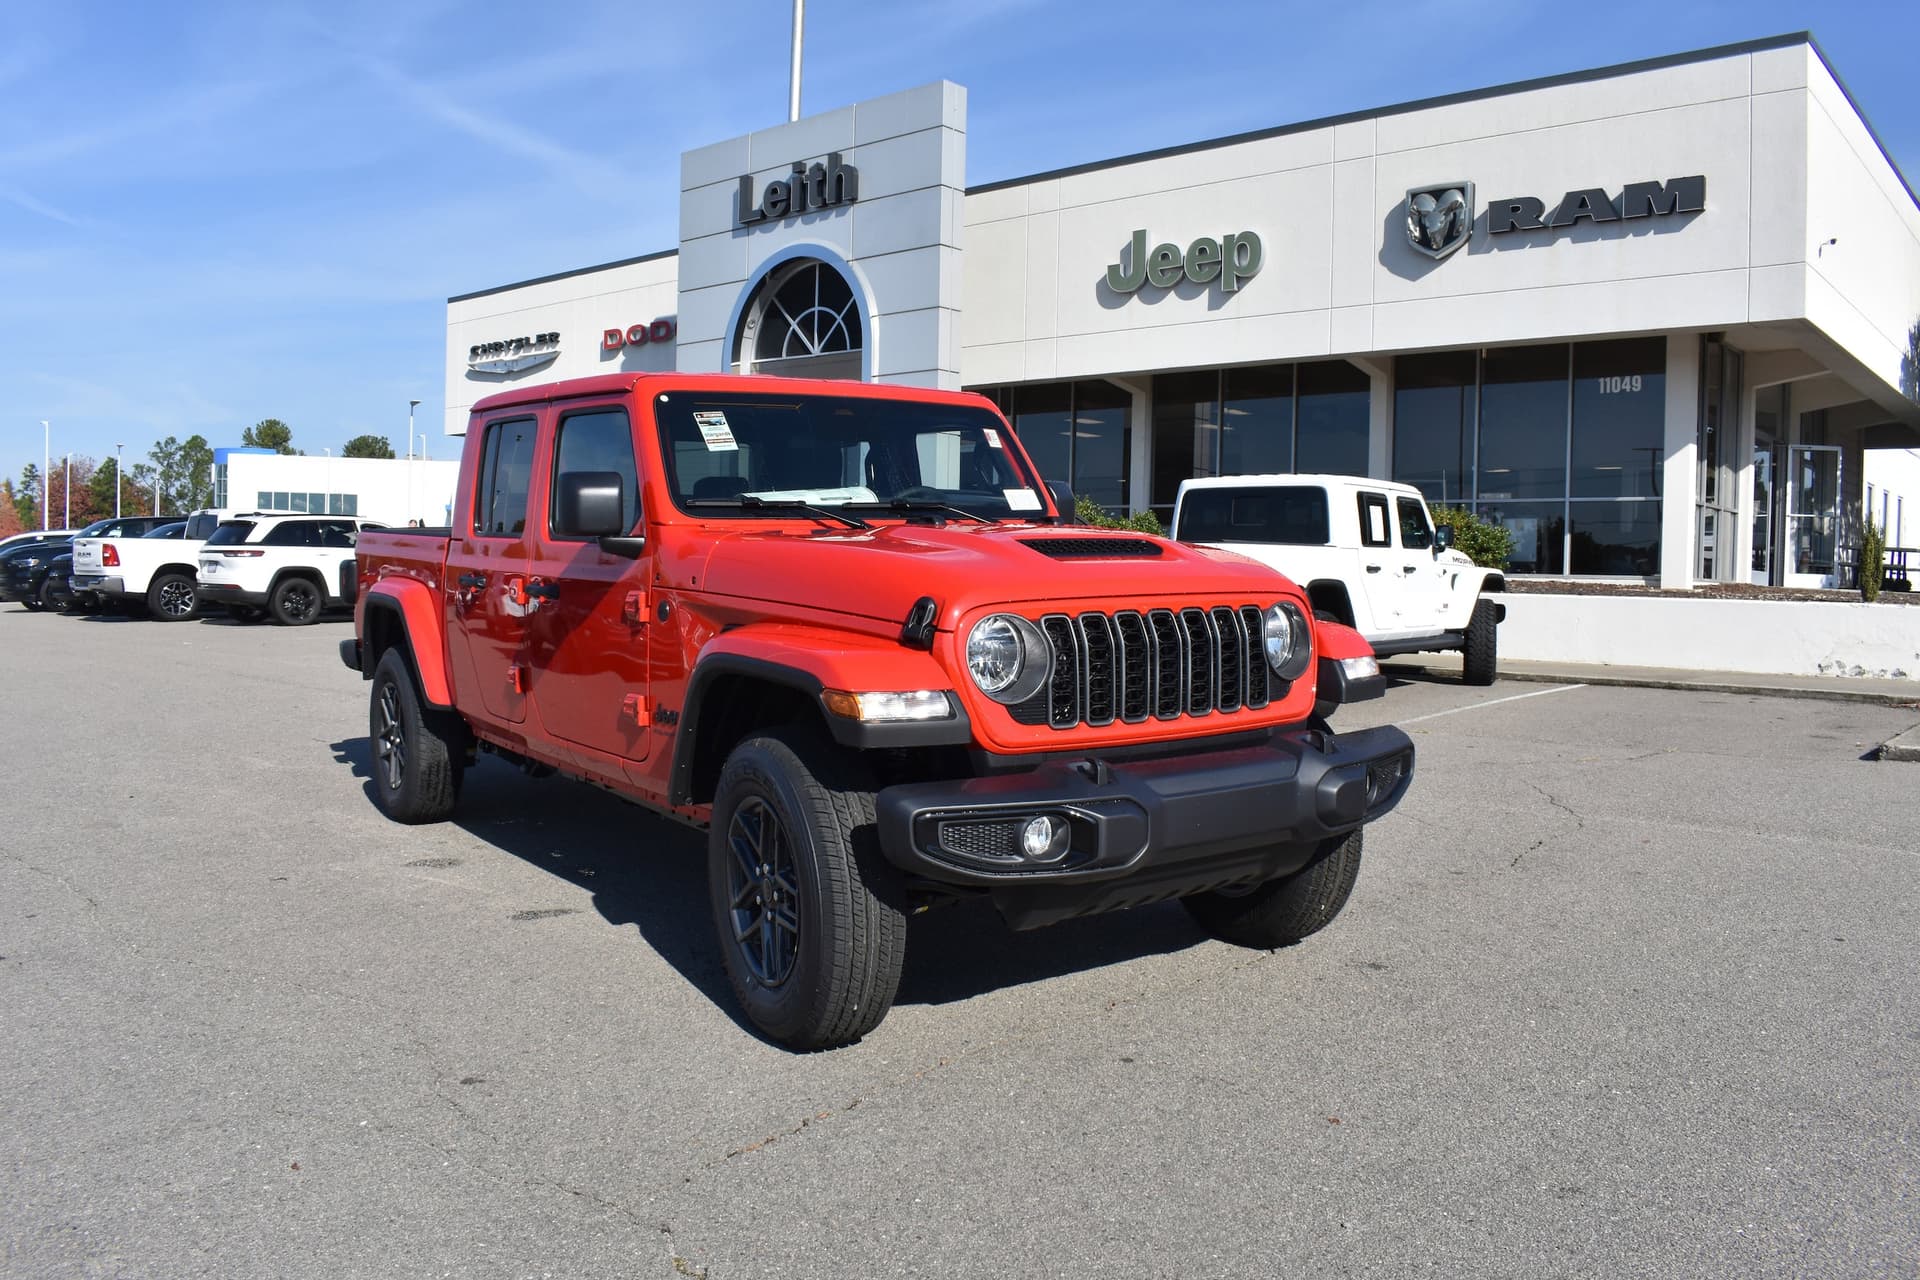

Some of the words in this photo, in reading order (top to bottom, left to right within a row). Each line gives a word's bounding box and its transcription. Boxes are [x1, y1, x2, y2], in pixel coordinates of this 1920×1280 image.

[738, 151, 859, 225] Leith
[1488, 175, 1707, 234] RAM
[1106, 229, 1263, 294] Jeep
[469, 331, 561, 356] CHRYSLER
[603, 320, 678, 350] DOD
[1598, 374, 1642, 395] 11049
